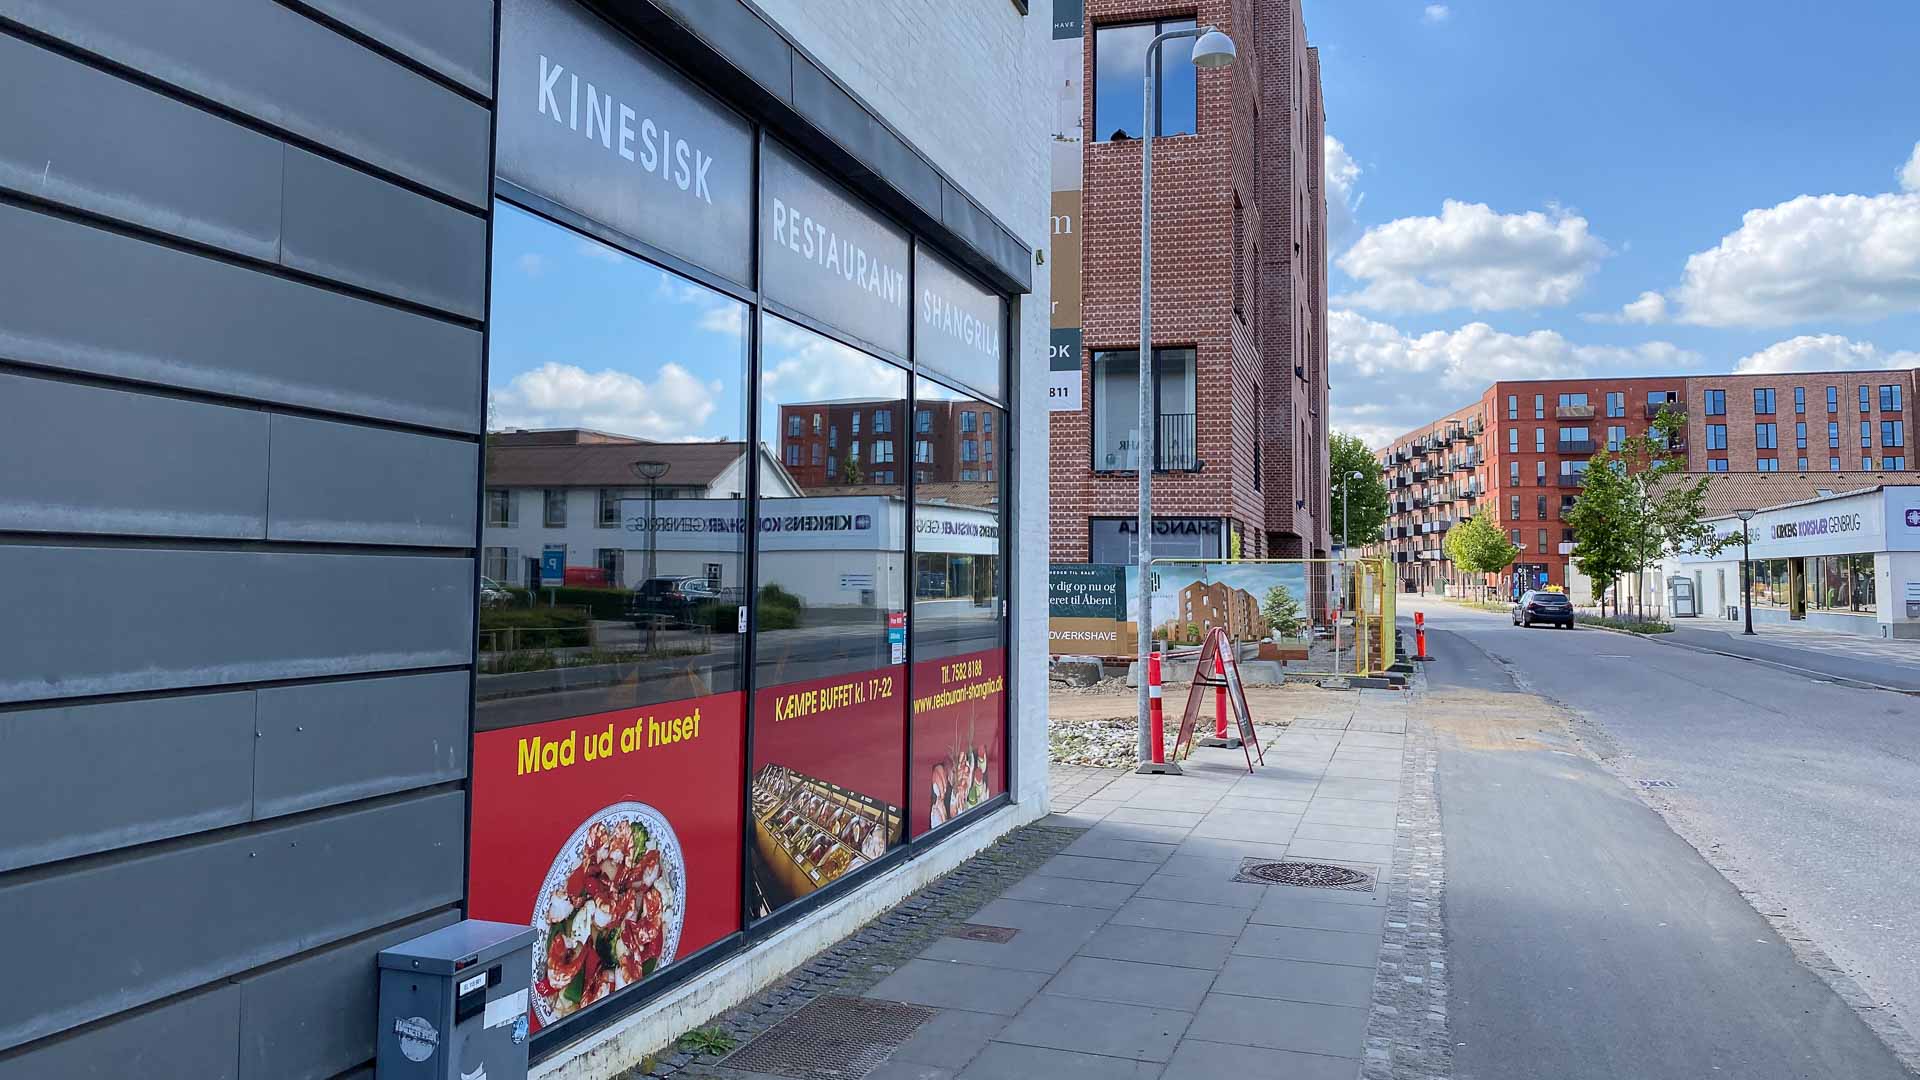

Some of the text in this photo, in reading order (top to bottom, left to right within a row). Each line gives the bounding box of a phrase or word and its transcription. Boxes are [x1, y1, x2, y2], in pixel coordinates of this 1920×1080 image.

[537, 54, 713, 205] KINESISK
[772, 196, 904, 309] RESTAURANT
[923, 292, 1000, 360] SHANGRILA
[1056, 580, 1072, 594] dig
[1073, 583, 1087, 594] op
[1088, 583, 1102, 592] nu
[1103, 583, 1117, 594] og
[1070, 594, 1081, 605] til
[1082, 593, 1112, 606] Åbent
[775, 676, 893, 722] KÆMPE BUFFET kl. 17-22
[951, 662, 967, 682] 7582
[967, 659, 982, 679] 8188
[516, 708, 701, 776] Mad ud af huset
